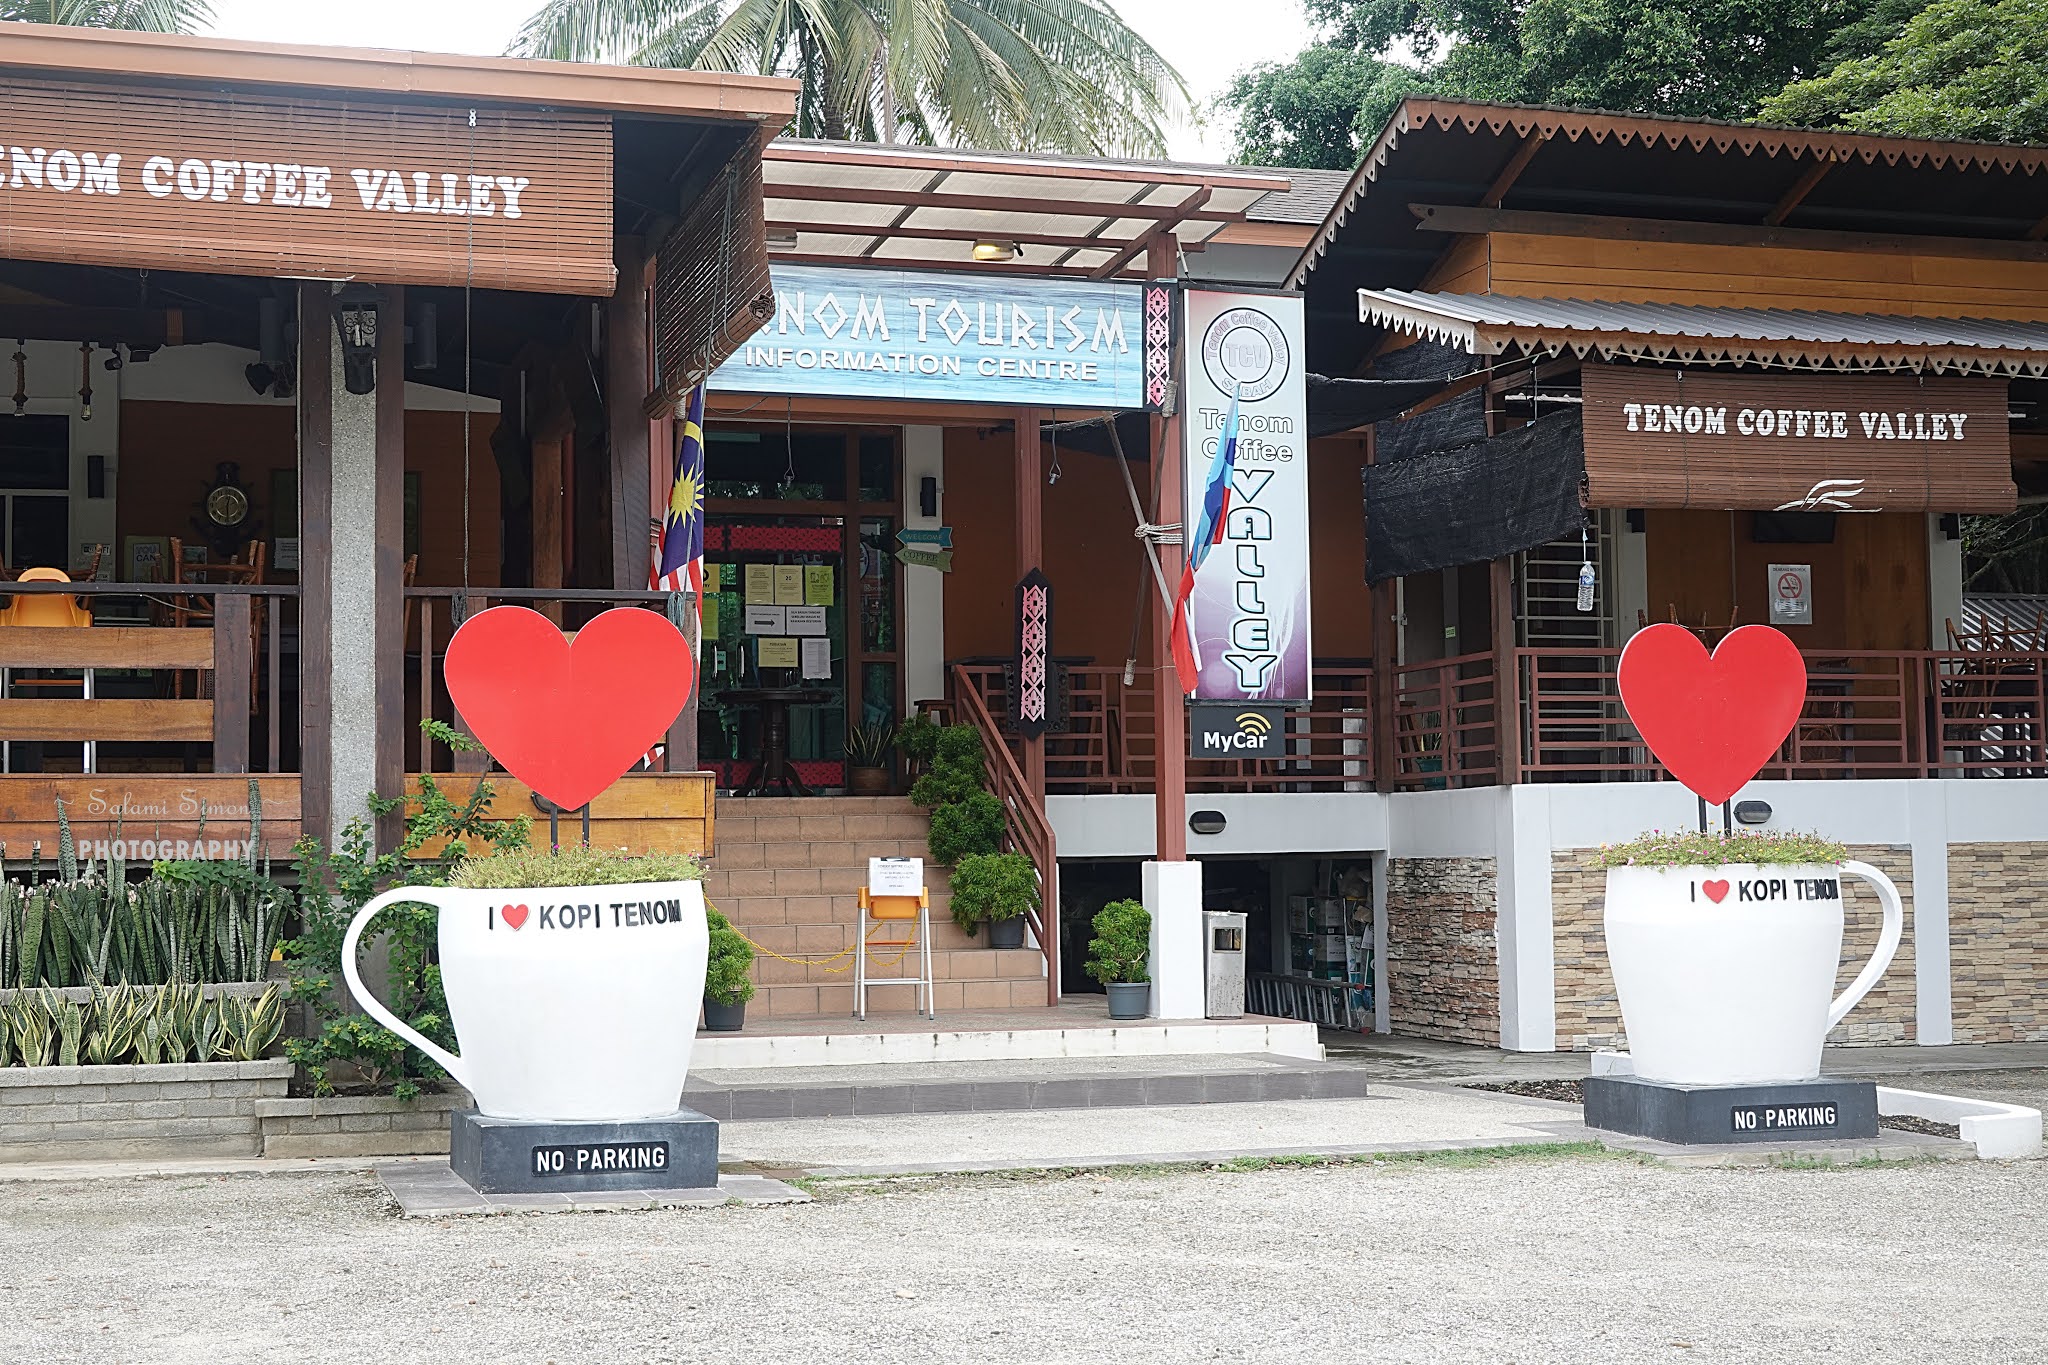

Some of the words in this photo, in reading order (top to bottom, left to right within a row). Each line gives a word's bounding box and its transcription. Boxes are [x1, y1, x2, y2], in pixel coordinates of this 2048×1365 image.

[0, 145, 122, 195] NOM
[142, 155, 333, 209] COFFEE
[350, 168, 530, 219] VALLEY
[761, 290, 891, 342] NOM
[909, 297, 1129, 354] TOURISM
[1205, 318, 1231, 361] Tenom
[1230, 311, 1268, 331] Coffee
[1267, 326, 1287, 366] Valley
[746, 346, 961, 376] INFORMATION
[977, 357, 1098, 381] CENTRE
[1225, 343, 1267, 369] TCV
[1623, 403, 1727, 435] TENOM
[1737, 408, 1849, 439] COFFEE
[1859, 412, 1968, 441] VALLEY
[903, 550, 938, 562] COFFEE
[1224, 468, 1278, 689] VALLEY
[1203, 731, 1268, 753] MyCar
[1690, 880, 1696, 903] I
[1738, 879, 1788, 902] KOPI
[488, 906, 494, 931] I
[539, 903, 601, 930] KOPI
[609, 898, 683, 928] TENOM
[1734, 1110, 1757, 1130] NO
[1765, 1106, 1836, 1128] PARKING
[536, 1150, 565, 1172] NO
[576, 1146, 666, 1171] PARKING
